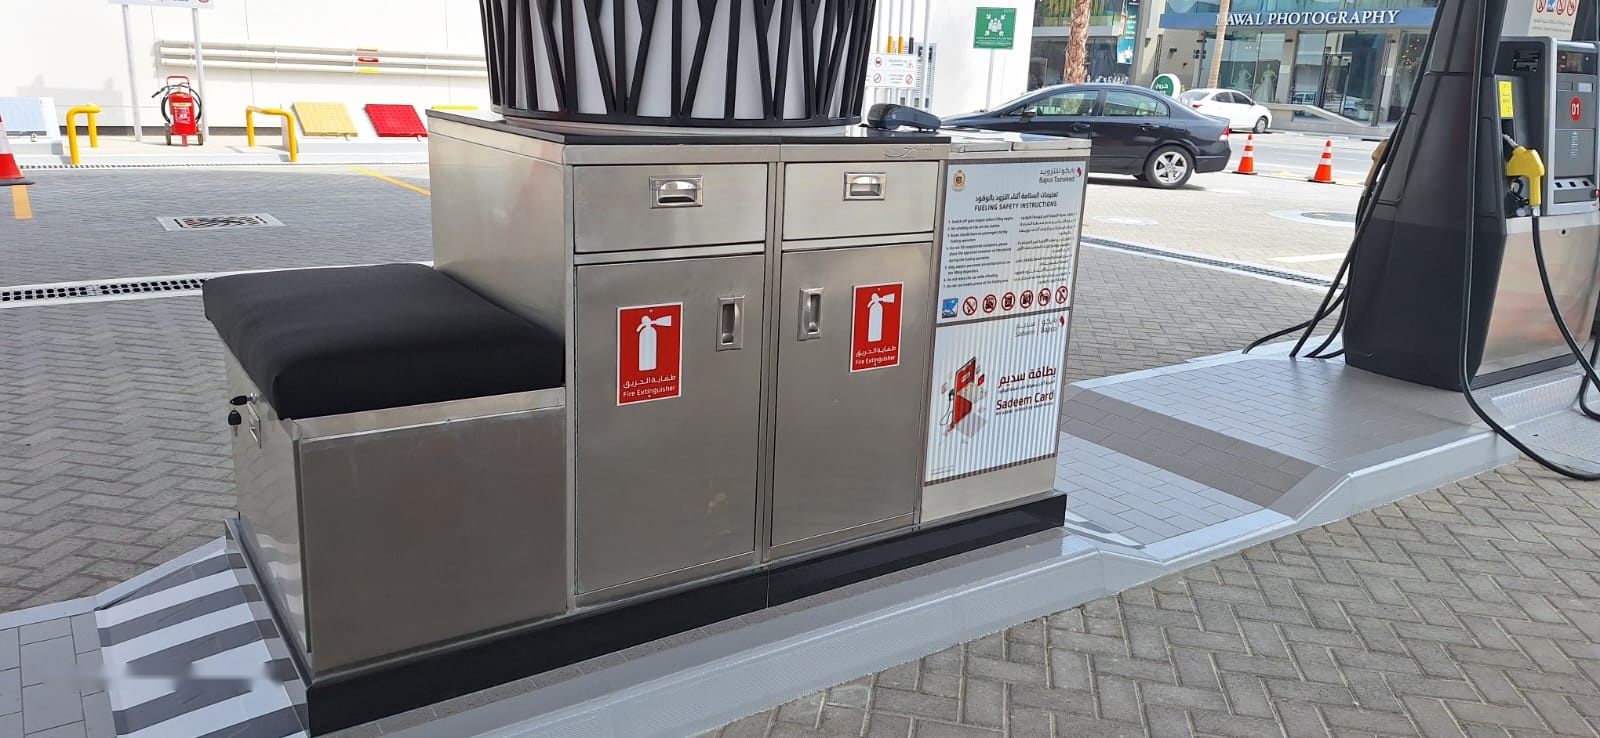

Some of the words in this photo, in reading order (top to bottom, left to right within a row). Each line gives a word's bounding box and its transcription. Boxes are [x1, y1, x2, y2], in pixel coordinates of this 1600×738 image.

[1268, 10, 1400, 25] PHOTOGRAPHY
[1571, 103, 1580, 116] 01
[974, 203, 998, 211] FUELING
[999, 202, 1019, 210] SAFETY
[1020, 201, 1057, 209] INSTRUCTIONS
[651, 374, 676, 384] طفاية
[1028, 366, 1056, 379] بطاقة
[623, 377, 651, 389] الحريق
[998, 372, 1026, 389] سديم
[636, 385, 676, 396] Extinguisher
[996, 396, 1033, 411] Sadeem
[1034, 390, 1055, 404] Card
